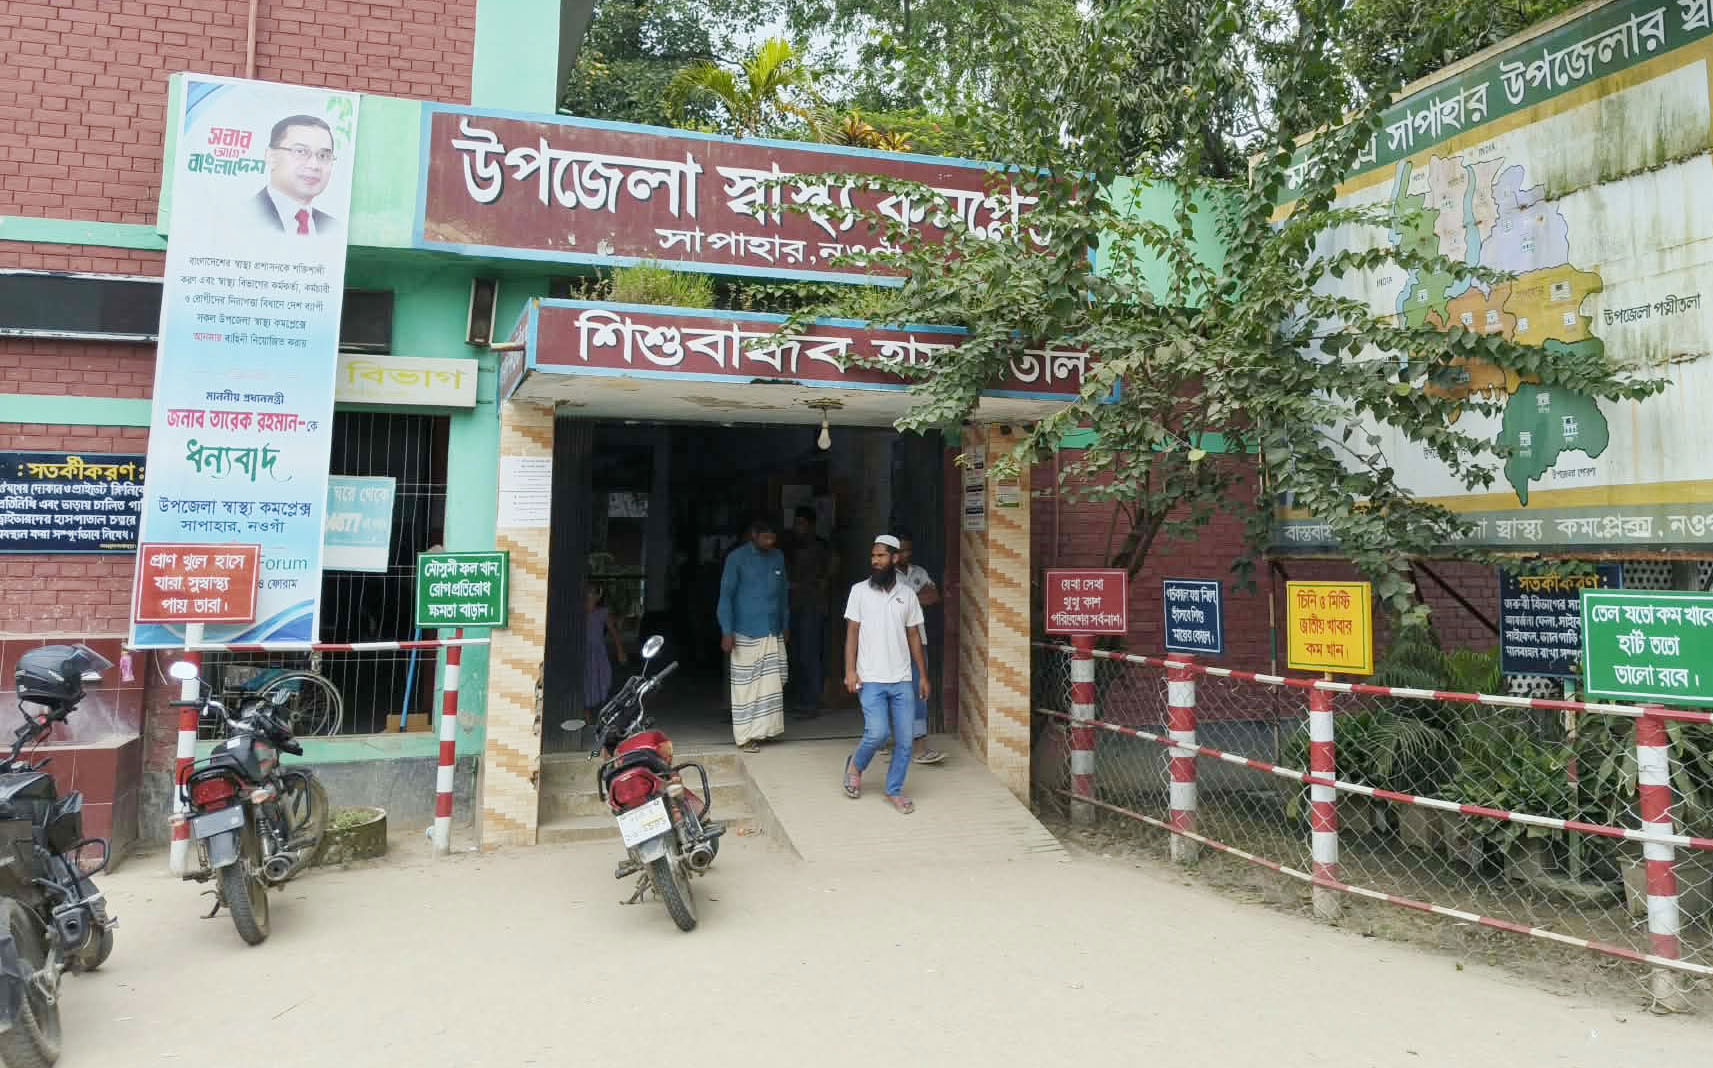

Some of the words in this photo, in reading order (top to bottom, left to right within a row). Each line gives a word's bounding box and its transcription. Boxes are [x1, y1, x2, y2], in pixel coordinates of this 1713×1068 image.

[1385, 82, 1489, 152] সাপাহার
[1500, 6, 1666, 105] উপজেলার
[207, 127, 253, 150] সবার
[187, 152, 266, 177] বাংলাদেশ
[451, 116, 703, 221] উপজেলা
[715, 160, 856, 240] স্বাস্থ্য
[654, 226, 817, 266] সাপাহার,
[199, 276, 215, 286] এবং
[217, 277, 235, 288] স্বাস্থ্য
[219, 313, 251, 326] উপজেলা
[254, 317, 272, 328] স্বাস্থ্য
[1603, 302, 1656, 329] উপজেলা
[346, 360, 468, 390] বিভাগ
[206, 389, 240, 402] মাননীয়
[243, 392, 285, 405] প্রধানমন্ত্রী
[167, 409, 206, 429] জনাব
[210, 410, 253, 432] তারেক
[186, 438, 293, 483] ধন্যবাদ
[39, 500, 59, 511] এবং
[94, 497, 125, 512] চালিত
[159, 496, 217, 515] উপজেলা
[222, 500, 256, 518] স্বাস্থ্য
[260, 501, 312, 517] কমপ্লেক্স
[247, 518, 286, 533] নওগাঁ
[1495, 517, 1544, 542] স্বাস্থ্য
[150, 553, 177, 569] প্রাণ
[183, 553, 208, 571] খুলে
[215, 554, 246, 570] হাসে
[424, 558, 457, 578] মৌসুমী
[459, 562, 479, 576] ফল
[188, 576, 231, 593] সুস্বাস্থ্য
[161, 598, 188, 613] পায়
[427, 603, 458, 618] ক্ষমতা
[1297, 590, 1317, 610] চিনি
[1320, 597, 1325, 609] ও
[1328, 590, 1351, 610] মিষ্টি
[1299, 613, 1324, 636] জাতীয়
[1327, 619, 1353, 636] খাবার
[1592, 605, 1620, 623] তেল
[1623, 605, 1654, 624] যতো
[1656, 606, 1682, 625] কম
[1304, 642, 1323, 657] কম
[1649, 635, 1680, 656] ততো
[1613, 664, 1654, 686] ভালো
